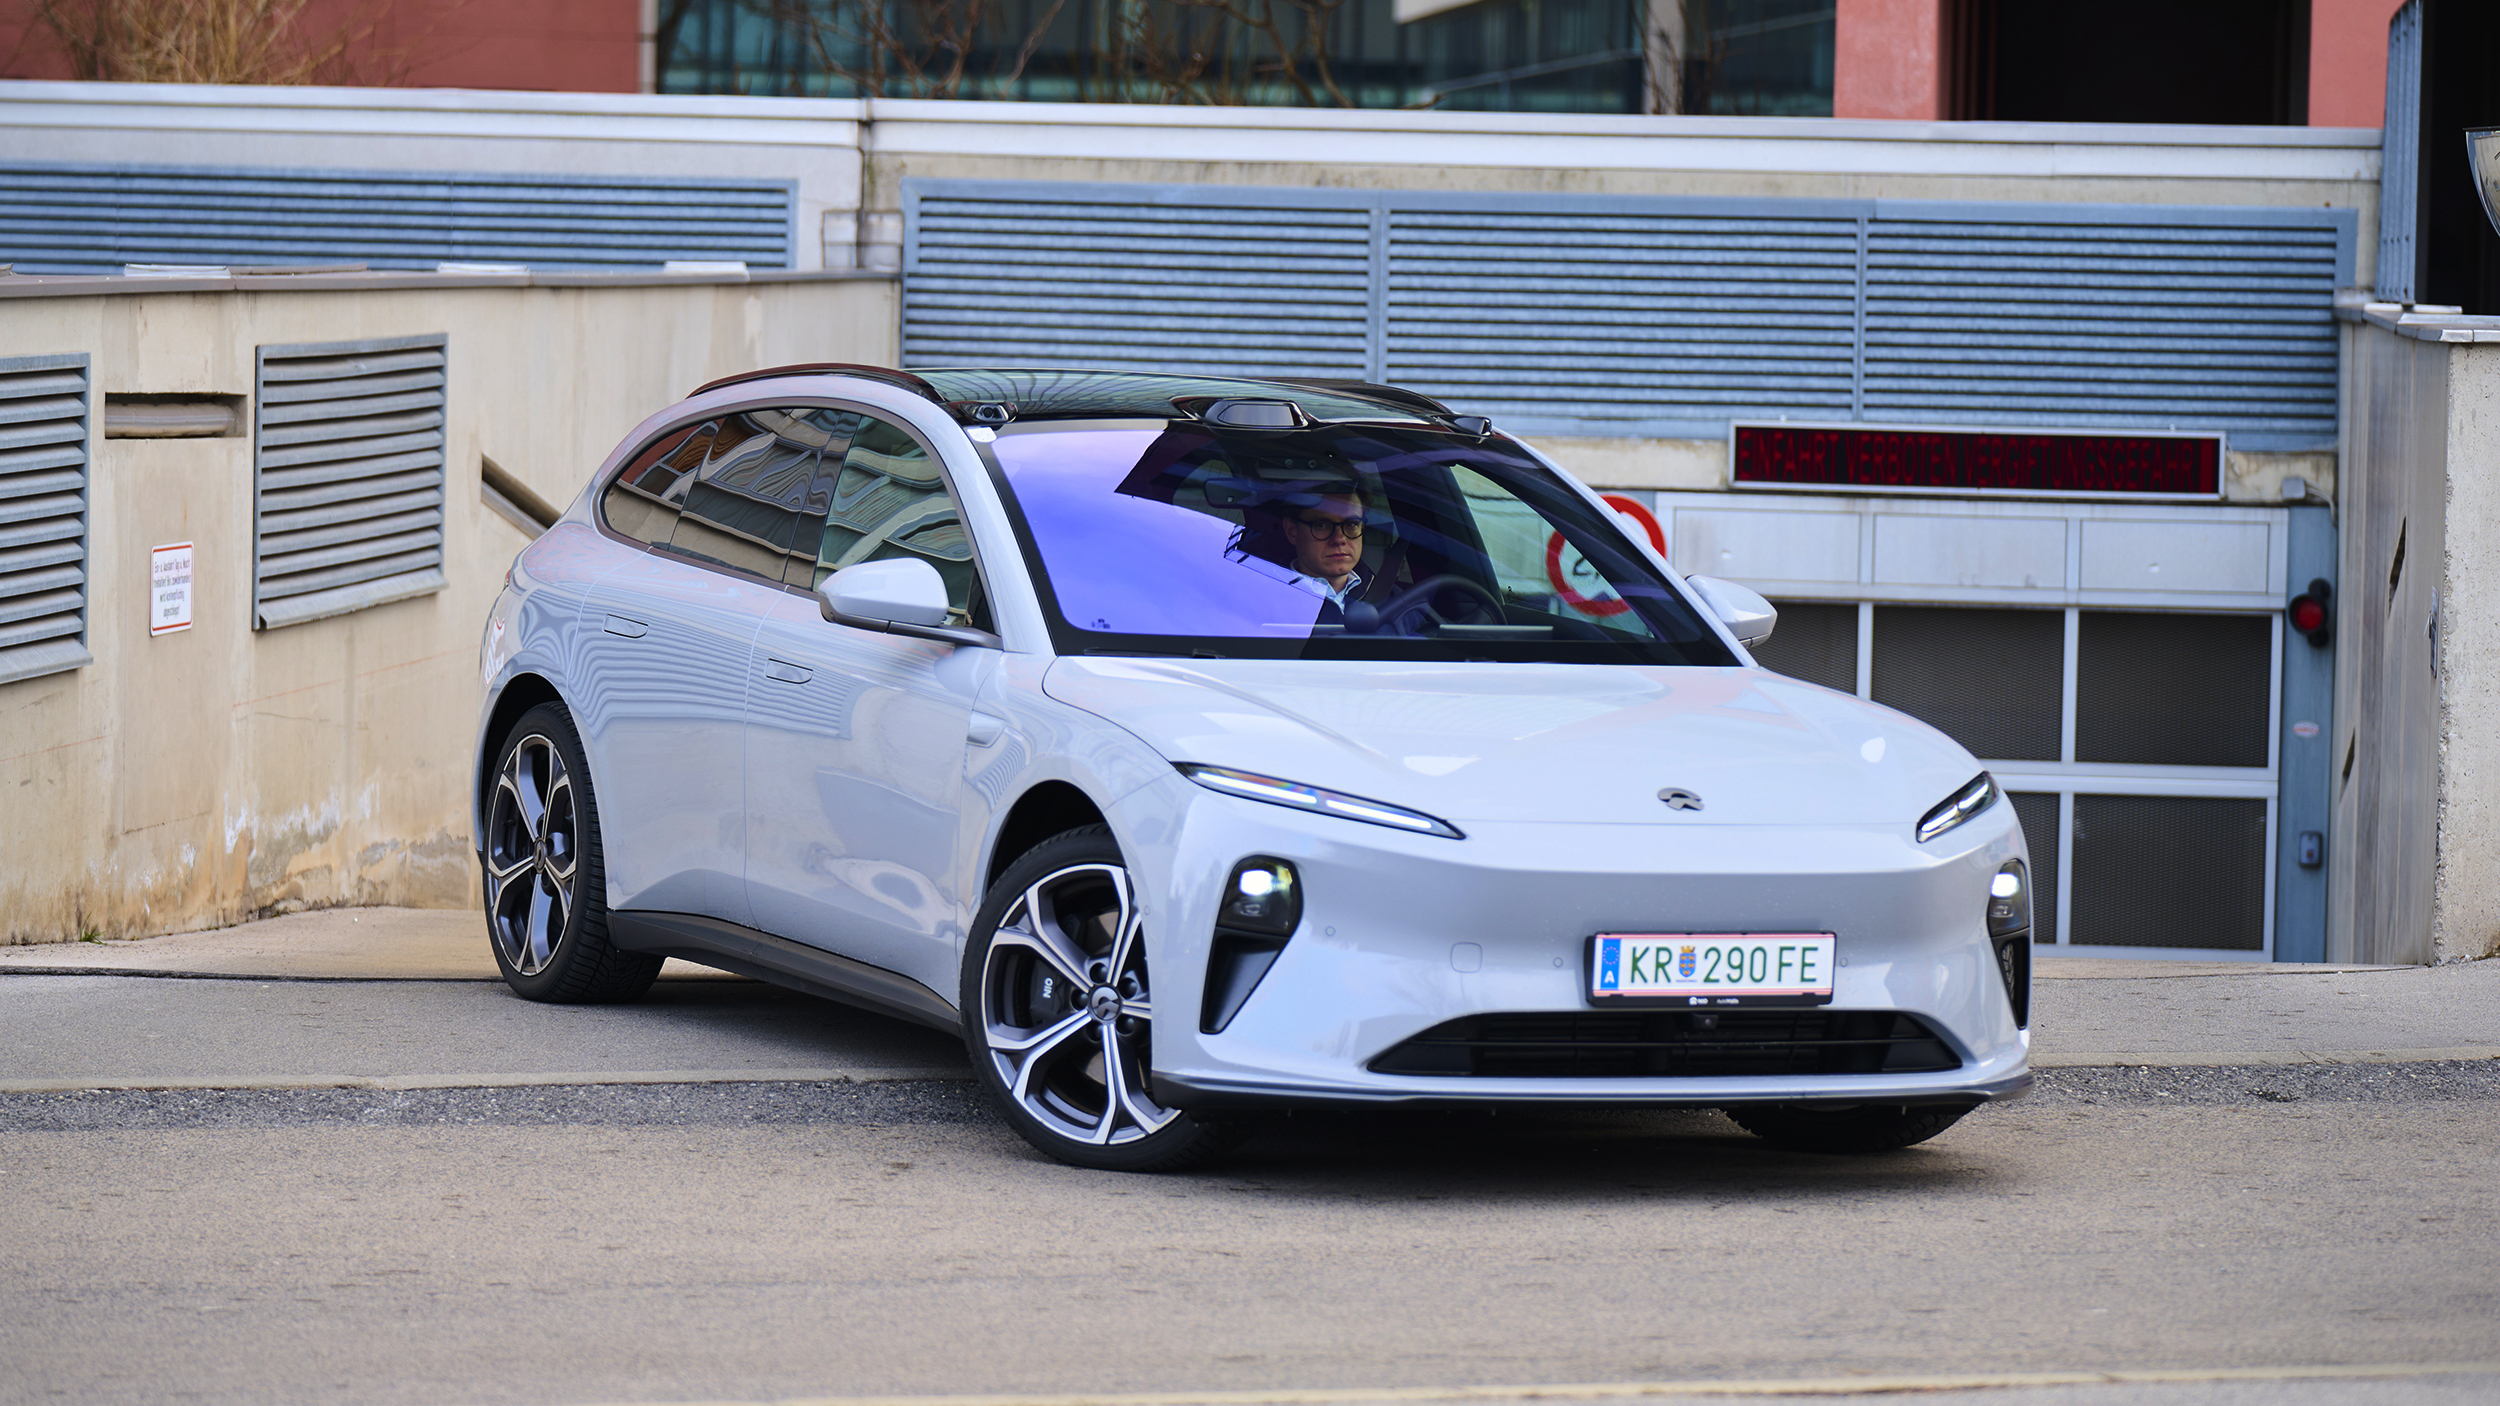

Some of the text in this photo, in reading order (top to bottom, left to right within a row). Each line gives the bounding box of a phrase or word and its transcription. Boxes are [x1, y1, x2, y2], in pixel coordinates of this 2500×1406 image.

[1739, 431, 2194, 491] EINFAHRT VERBOTEN VERGIFTUNGSGEFAHR
[1604, 971, 1615, 983] A
[1630, 946, 1819, 984] KR 290 FE
[1043, 977, 1054, 998] NIO
